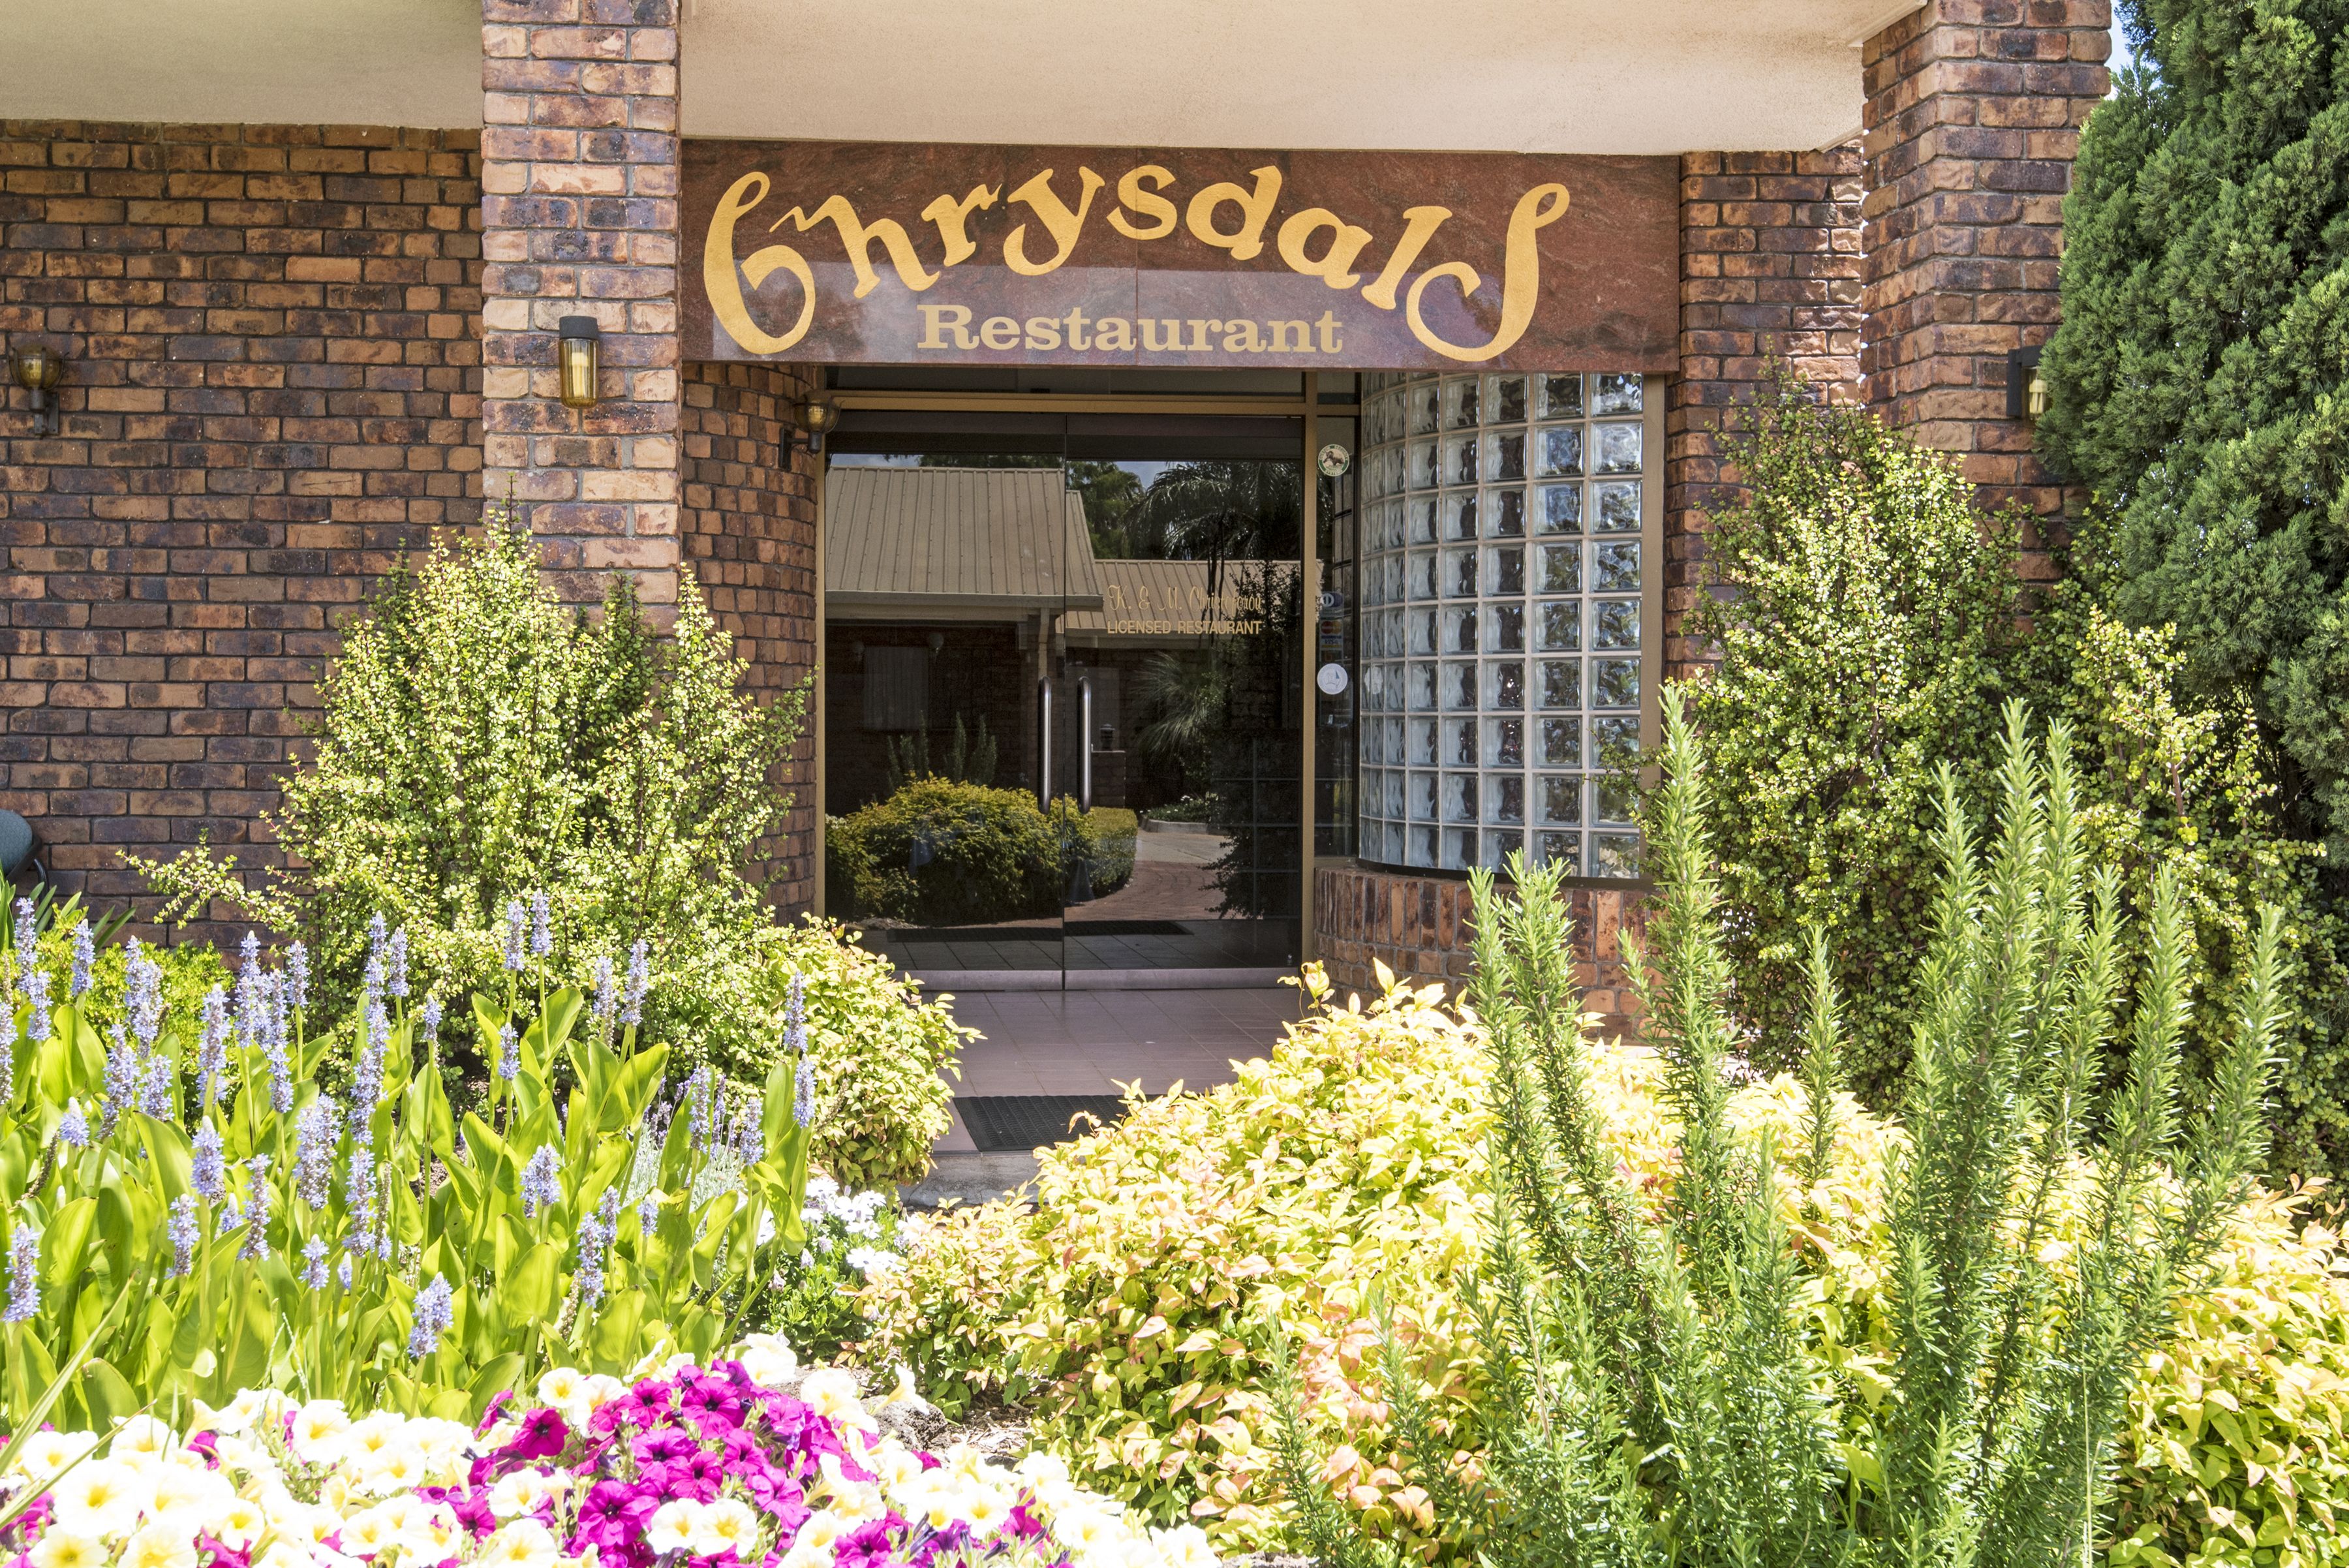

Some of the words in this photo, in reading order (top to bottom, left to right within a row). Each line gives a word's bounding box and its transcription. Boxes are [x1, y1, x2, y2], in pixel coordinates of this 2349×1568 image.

[917, 303, 1343, 353] Restaurant
[1138, 586, 1150, 610] &
[1107, 620, 1171, 634] LICENSED
[1178, 620, 1263, 634] RESTAURANT
